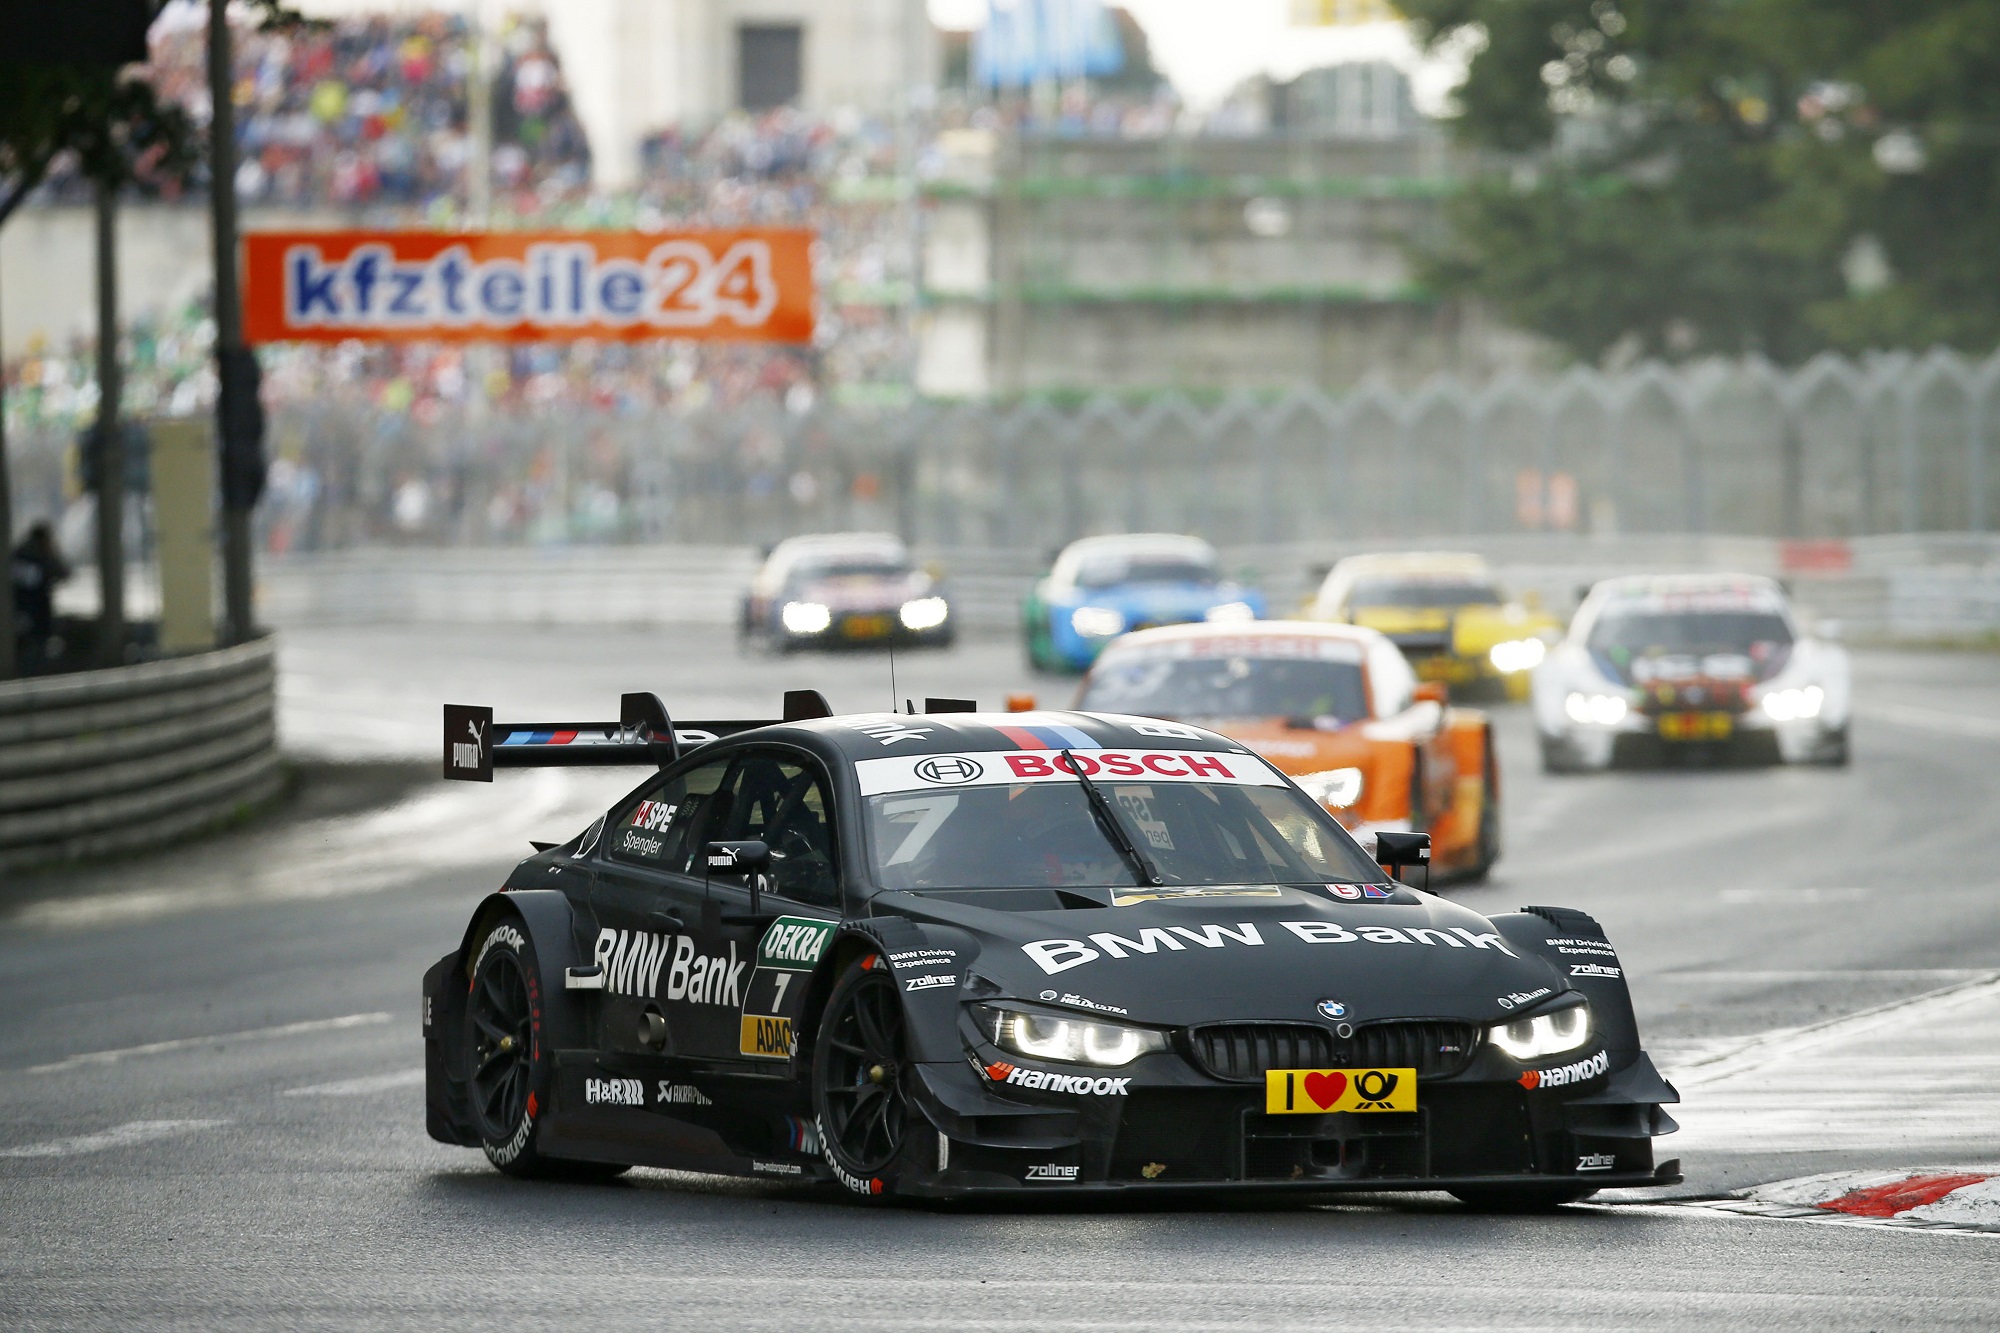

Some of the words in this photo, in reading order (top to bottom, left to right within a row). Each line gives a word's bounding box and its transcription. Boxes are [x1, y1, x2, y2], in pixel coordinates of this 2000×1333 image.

[289, 246, 770, 321] kfzteile24
[453, 742, 479, 769] PUMA
[1003, 754, 1236, 779] BOSCH
[644, 801, 678, 834] SPE
[883, 794, 959, 867] 7
[623, 830, 662, 856] Spengler
[708, 855, 732, 866] PUMA
[765, 923, 829, 963] DEKRA
[889, 951, 918, 961] BMW
[918, 949, 957, 957] Driving
[1020, 922, 1265, 976] BMW
[1278, 920, 1520, 960] Bank
[1545, 938, 1574, 946] BMW
[1575, 939, 1612, 950] Driving
[1558, 946, 1615, 957] Experience
[595, 927, 671, 998] BMW
[667, 934, 746, 1008] Bank
[893, 957, 951, 969] Experience
[756, 1018, 791, 1054] ADAC
[586, 1078, 626, 1104] H&R
[753, 1159, 802, 1175] bmw-motorsport.com
